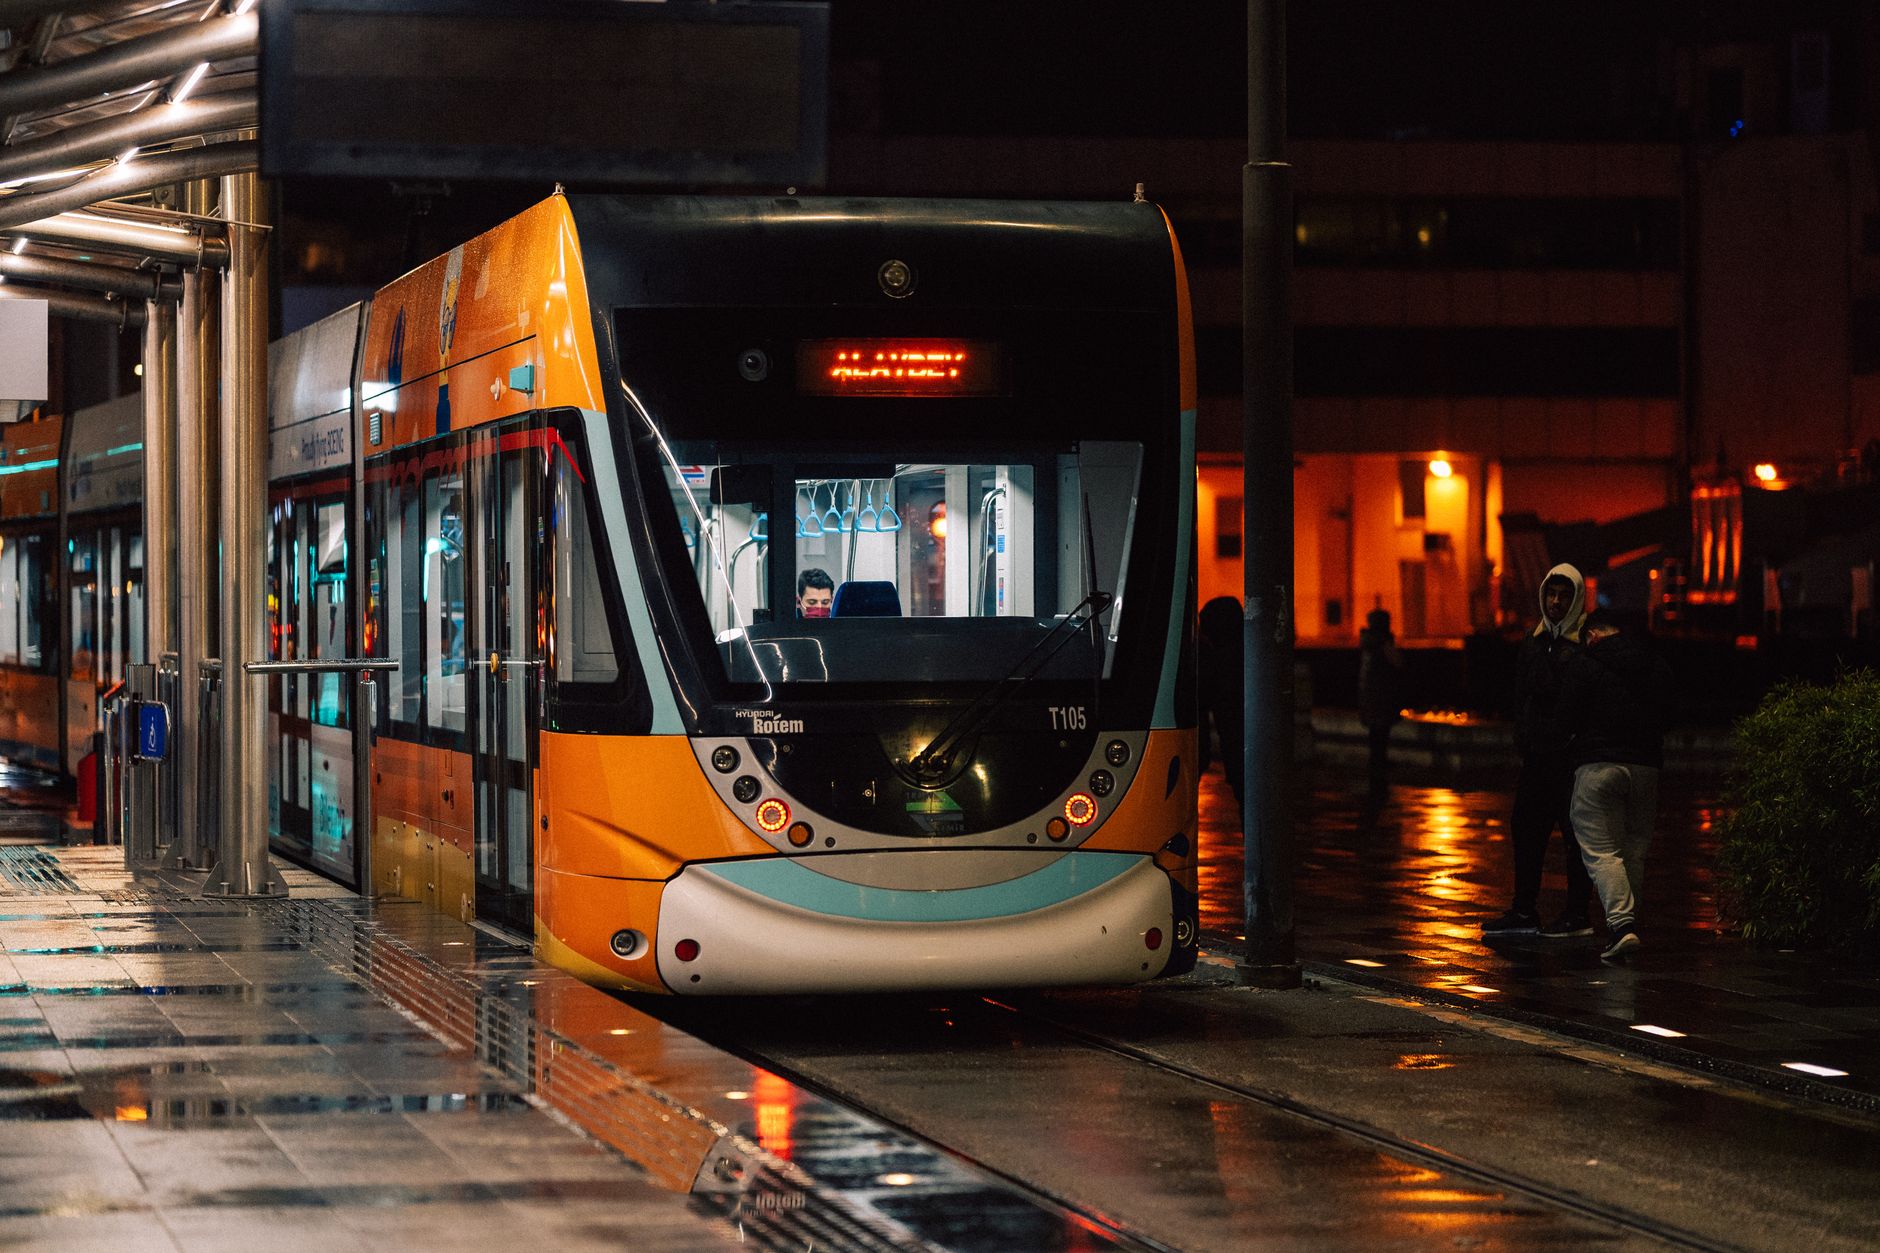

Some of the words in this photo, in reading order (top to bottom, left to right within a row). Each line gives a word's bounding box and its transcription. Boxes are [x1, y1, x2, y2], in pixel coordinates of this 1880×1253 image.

[735, 710, 774, 718] HYUNDAI
[753, 713, 804, 734] Rotem
[1048, 706, 1086, 730] T105
